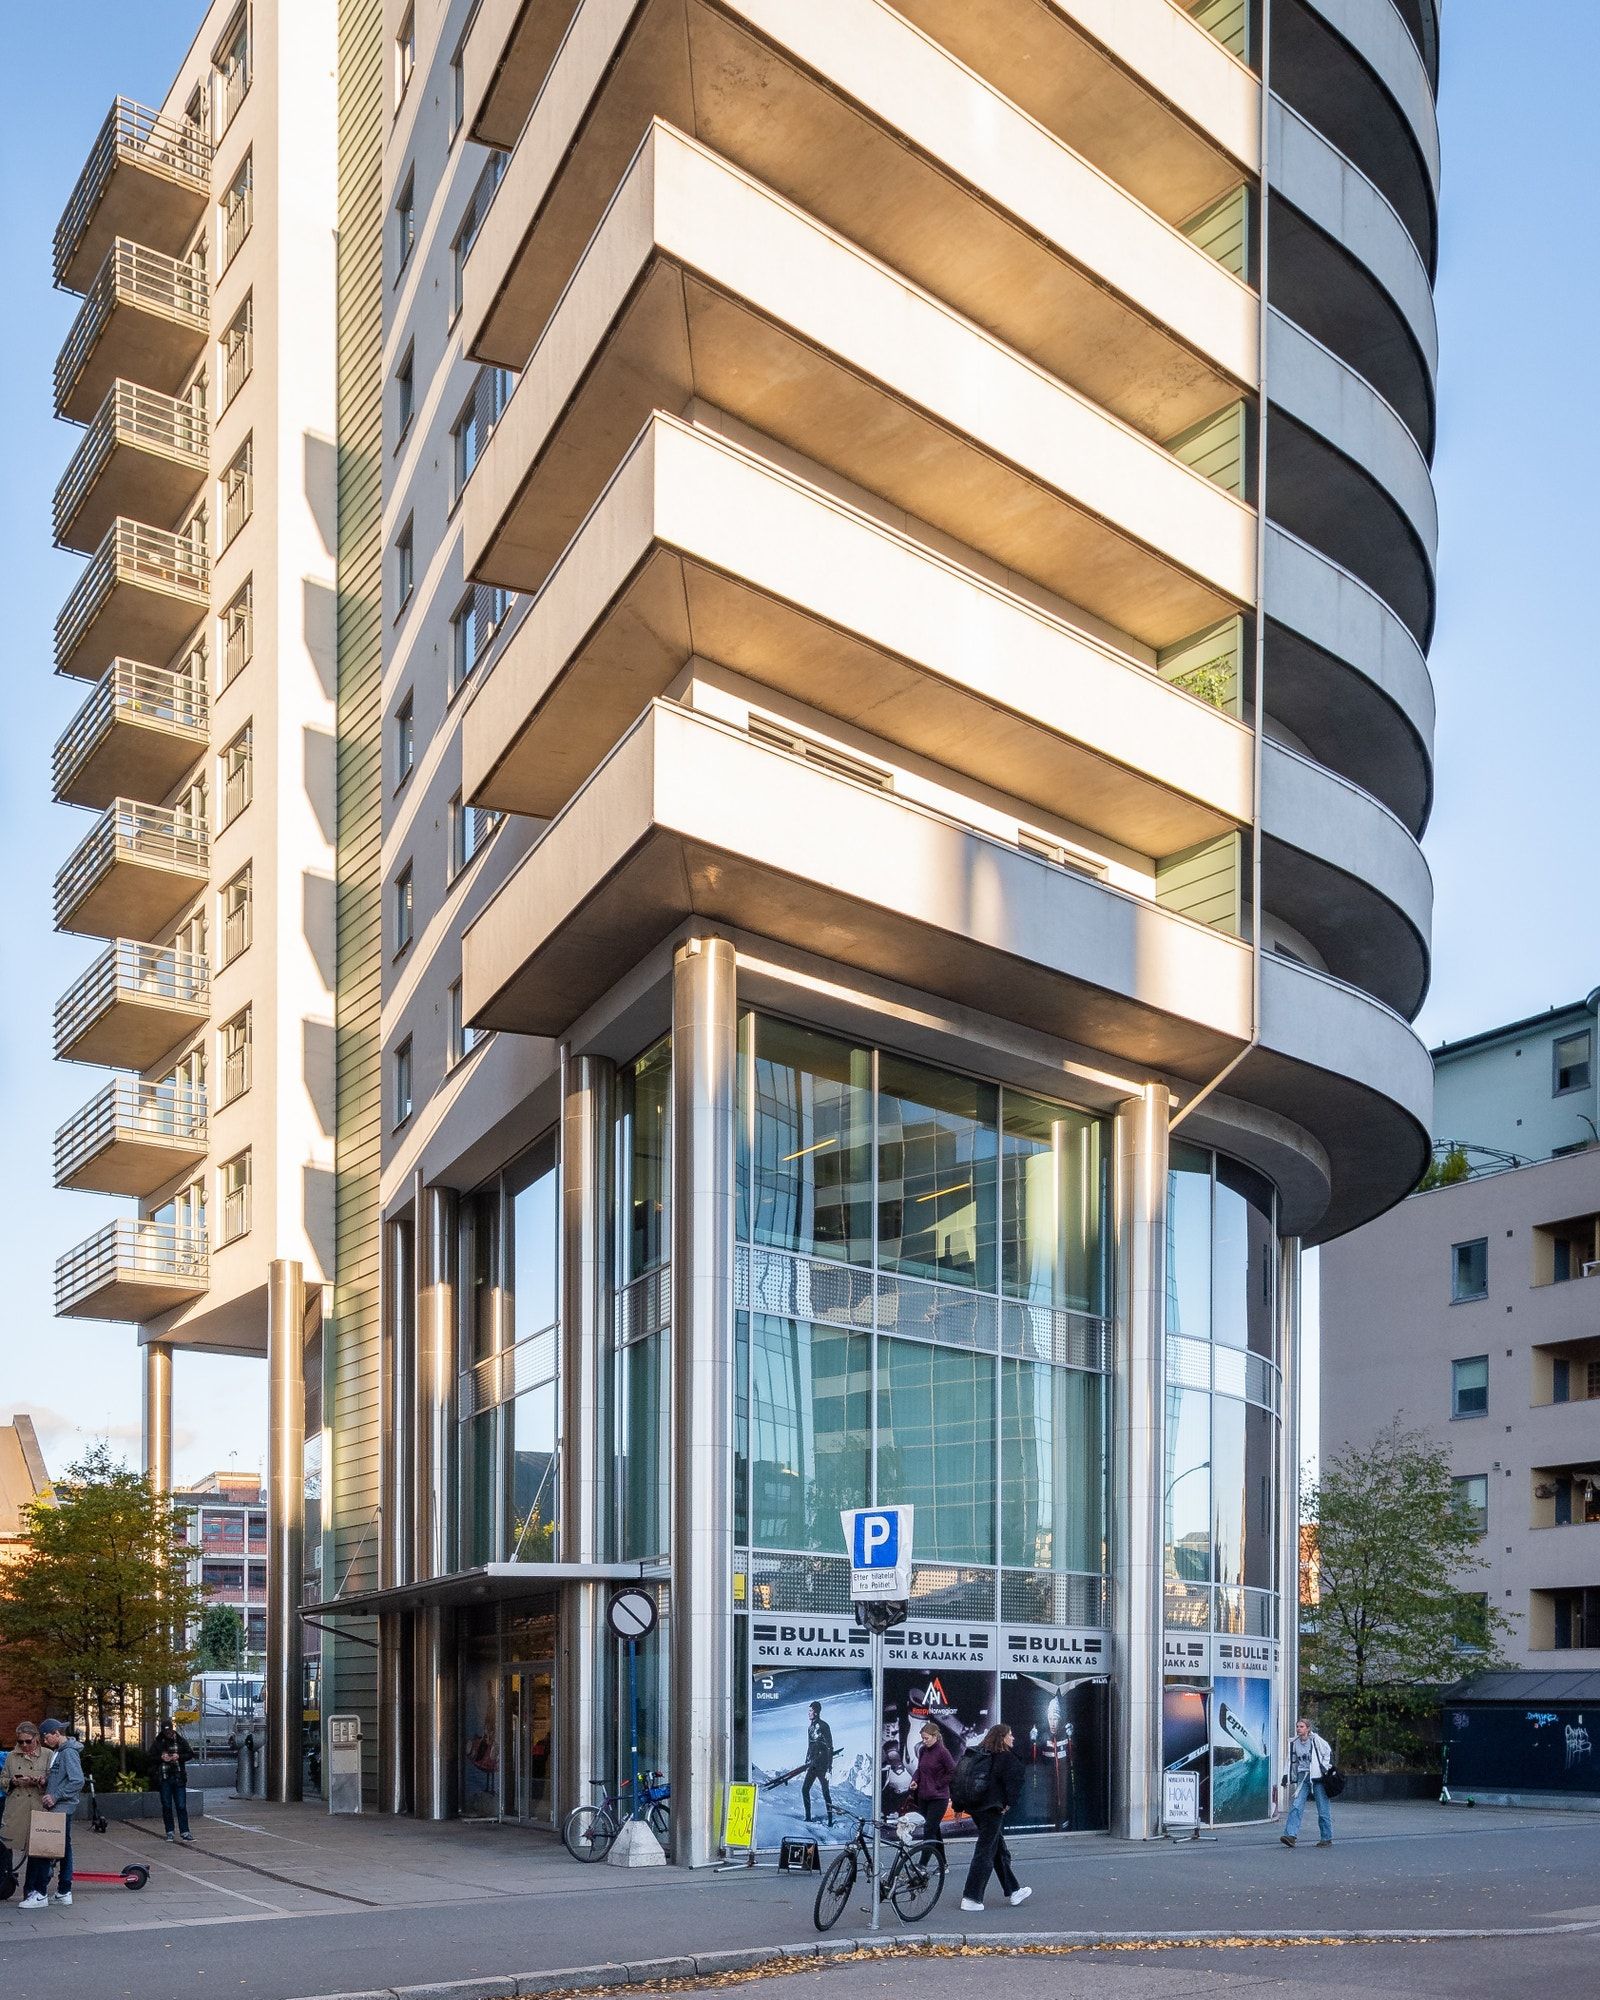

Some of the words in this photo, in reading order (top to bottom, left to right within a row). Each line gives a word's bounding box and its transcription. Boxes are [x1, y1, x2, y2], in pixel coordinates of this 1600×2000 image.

[864, 1516, 890, 1564] P
[781, 1626, 846, 1643] BULL
[908, 1631, 967, 1647] BULL
[1030, 1637, 1083, 1652] BULL
[1165, 1642, 1186, 1655] LL
[758, 1646, 779, 1655] SKI
[784, 1646, 793, 1656] &
[797, 1647, 846, 1658] KAJAKK
[849, 1649, 865, 1658] AS
[889, 1650, 907, 1659] SKI
[911, 1650, 919, 1660] &
[923, 1651, 967, 1661] KAJAKK
[970, 1653, 984, 1661] AS
[1234, 1646, 1261, 1659] BULL
[1012, 1654, 1029, 1663] SKI
[1032, 1655, 1039, 1663] &
[1043, 1655, 1082, 1665] KAJAKK
[1085, 1657, 1098, 1665] AS
[1188, 1660, 1200, 1668] AS
[1222, 1661, 1234, 1669] SKI
[1235, 1661, 1240, 1669] &
[1241, 1662, 1261, 1671] KAJAKK
[1226, 1714, 1249, 1737] epic
[1168, 1787, 1195, 1802] HOKA
